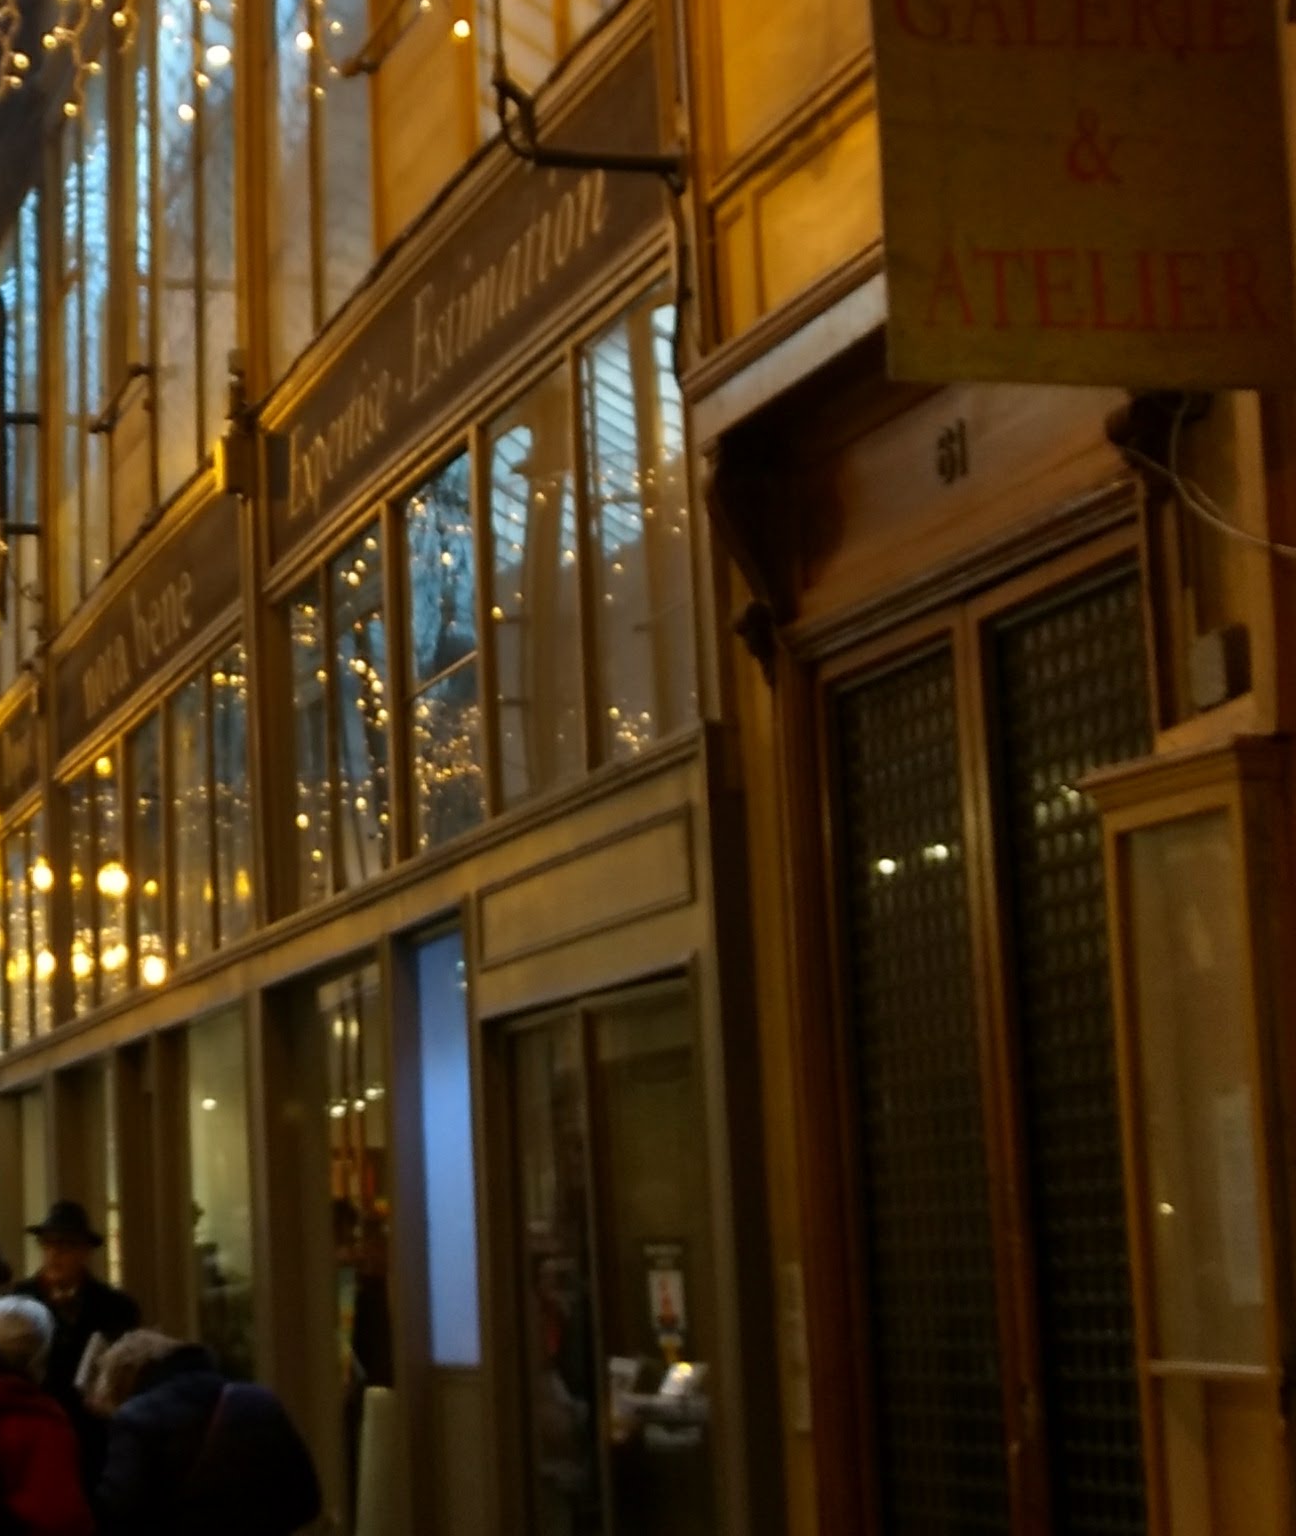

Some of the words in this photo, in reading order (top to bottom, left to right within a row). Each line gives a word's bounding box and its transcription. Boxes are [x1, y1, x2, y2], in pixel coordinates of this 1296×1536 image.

[1066, 108, 1123, 186] &
[410, 168, 607, 402] Estimation
[923, 236, 1276, 331] ATELIER
